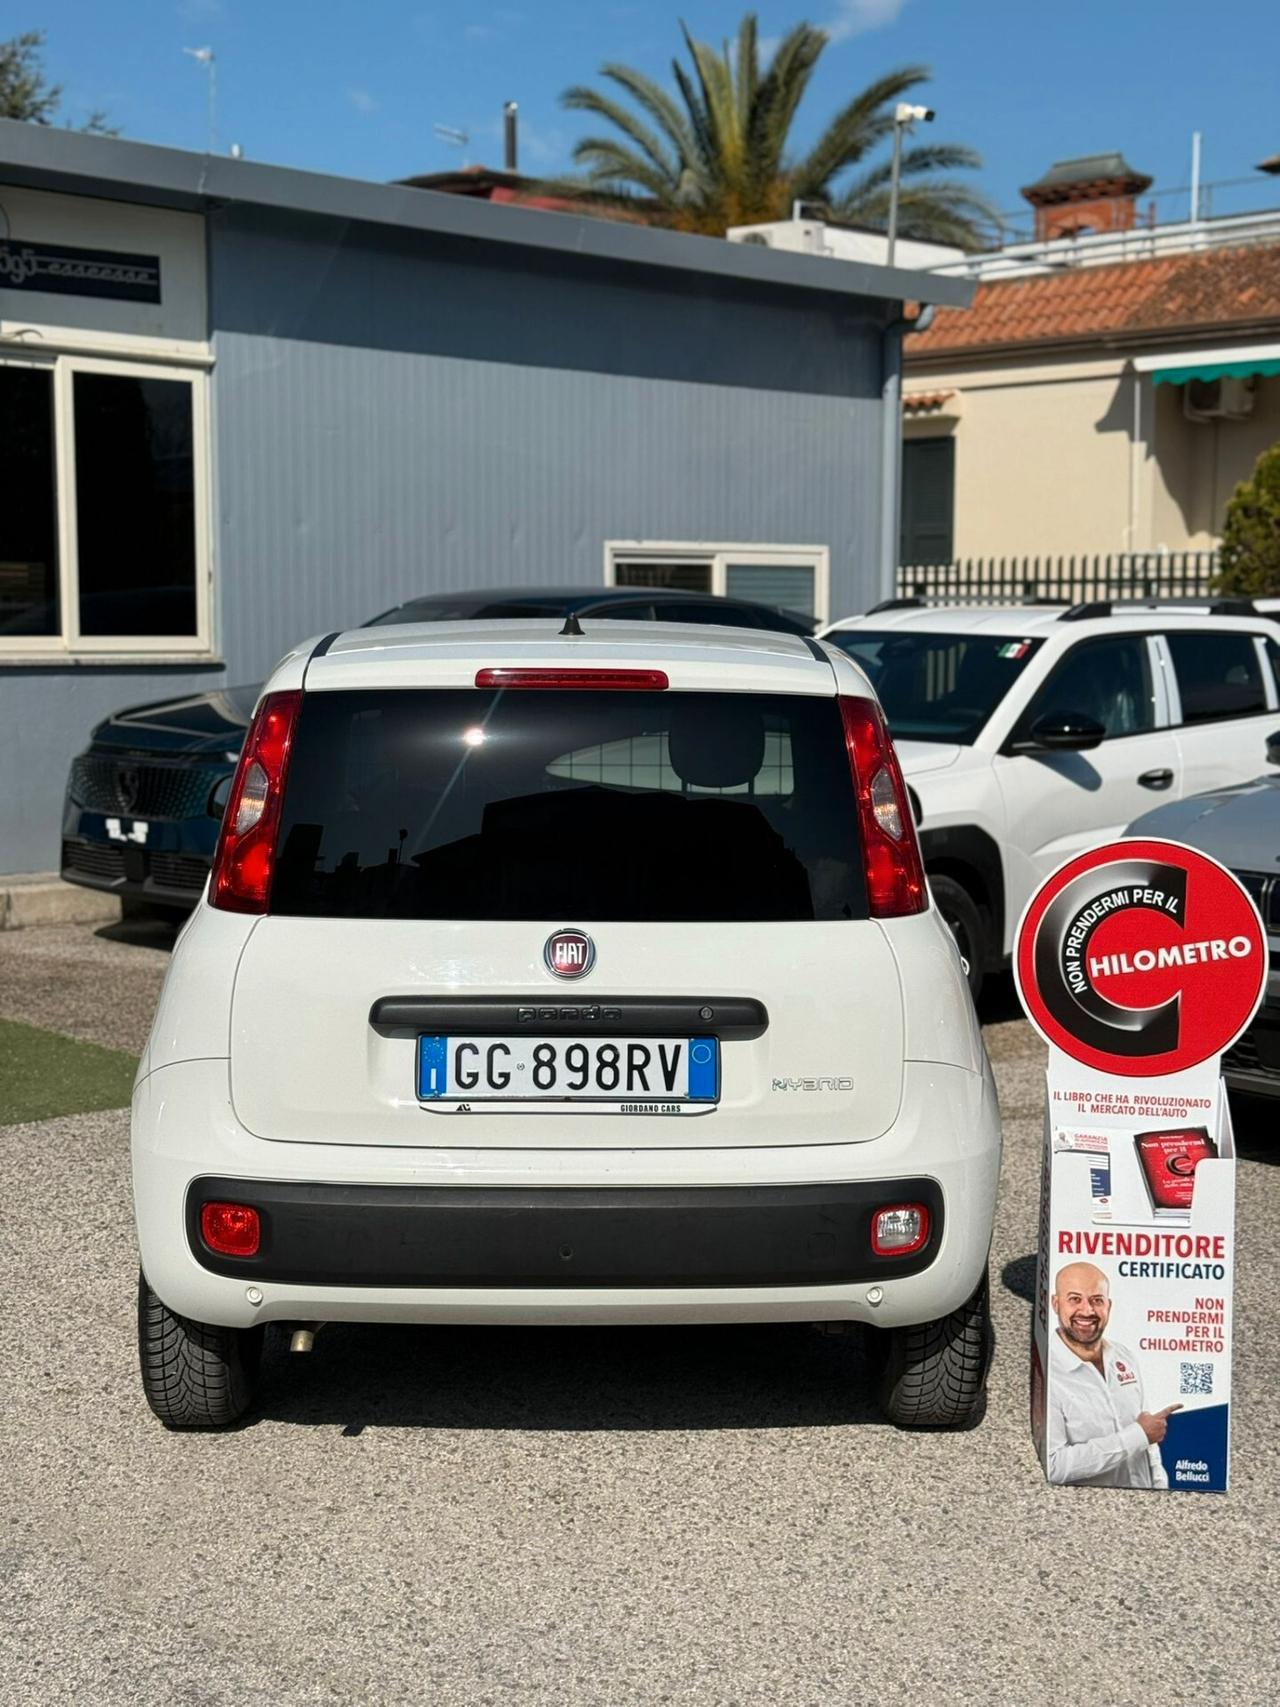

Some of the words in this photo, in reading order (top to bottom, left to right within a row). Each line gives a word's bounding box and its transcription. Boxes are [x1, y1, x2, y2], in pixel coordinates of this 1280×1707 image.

[1133, 889, 1165, 907] PER
[1165, 897, 1179, 914] IL
[1066, 890, 1130, 957] PRENDERMI
[555, 942, 586, 965] FIAT
[1066, 962, 1088, 994] NON
[454, 1043, 511, 1090] GG
[532, 1043, 682, 1091] 898RV
[430, 1068, 437, 1089] I
[772, 1077, 854, 1091] HYBRID
[620, 1104, 658, 1113] GIORDANO
[661, 1104, 681, 1113] CARS
[1053, 1091, 1062, 1101] IL
[1064, 1092, 1092, 1103] LIBRO
[1095, 1093, 1114, 1104] CHE
[1116, 1094, 1129, 1104] HA
[1134, 1095, 1212, 1109] RIVOLUZIONATO
[1078, 1103, 1086, 1113] IL
[1091, 1104, 1136, 1116] MERCATO
[1138, 1106, 1188, 1118] DELL'AUTO
[1058, 1231, 1225, 1259] RIVENDITORE
[1118, 1261, 1225, 1280] CERTIFICATO
[1195, 1298, 1224, 1310] NON
[1147, 1310, 1224, 1325] PRENDERMI
[1185, 1326, 1209, 1338] PER
[1213, 1327, 1225, 1339] IL
[1139, 1338, 1224, 1353] CHILOMETRO
[1175, 1460, 1208, 1471] Alfredo
[1175, 1471, 1210, 1482] Bellucci
